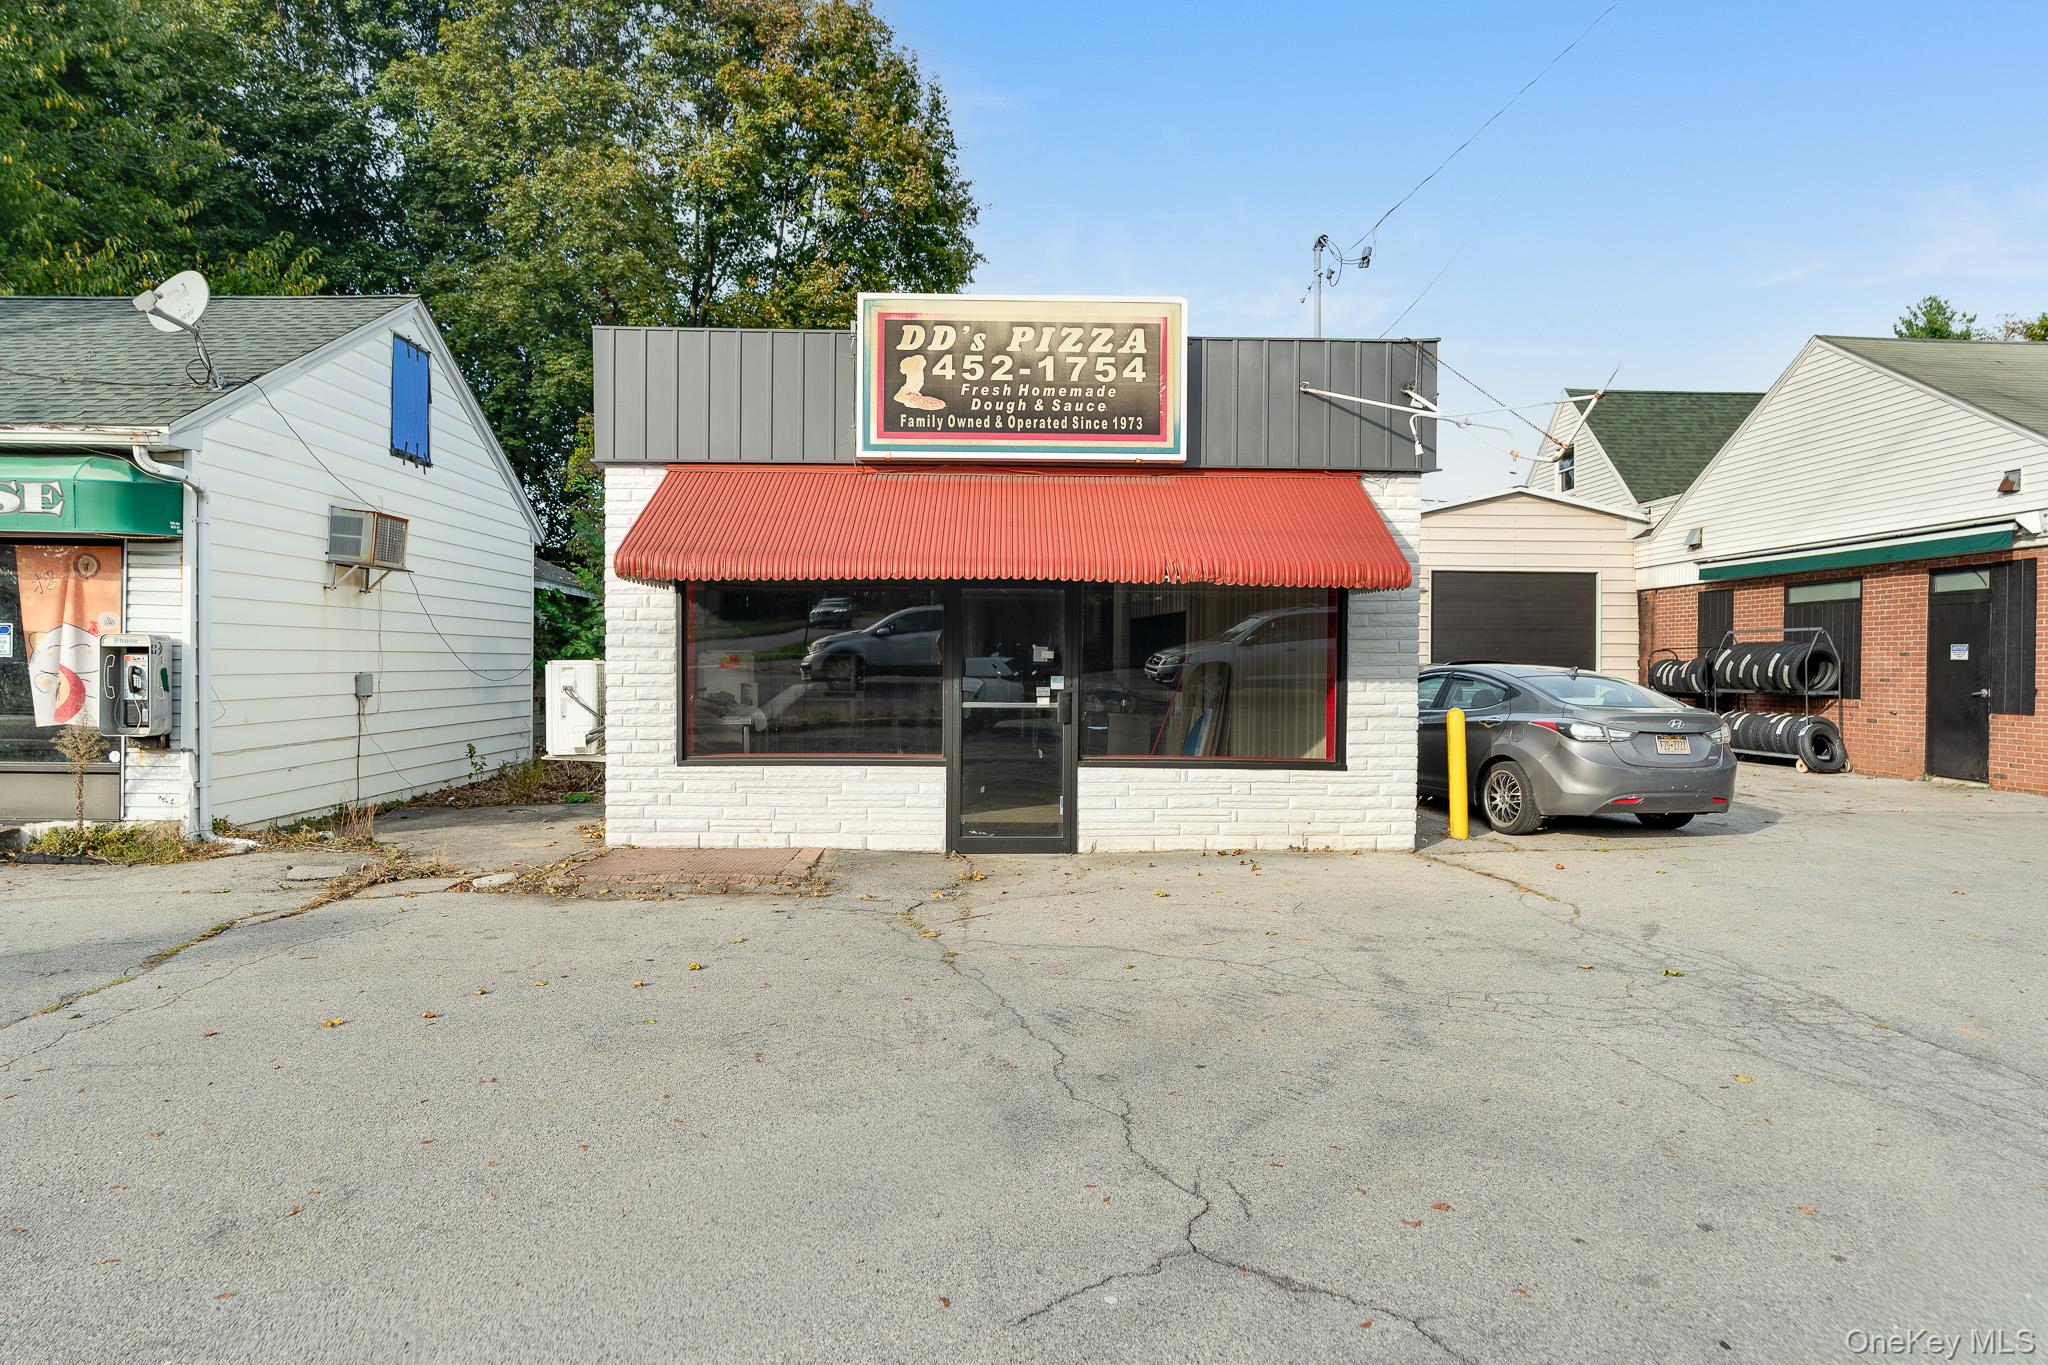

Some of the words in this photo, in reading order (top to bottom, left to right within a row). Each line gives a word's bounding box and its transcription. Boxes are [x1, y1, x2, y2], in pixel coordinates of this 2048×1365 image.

[895, 324, 987, 352] DD's
[1006, 326, 1147, 354] PIZZA
[932, 354, 1147, 383] 452-1754
[961, 383, 1012, 396] Fresh
[1018, 384, 1117, 398] Homemade
[971, 398, 1027, 414] Dough
[1034, 399, 1044, 411] &
[1051, 399, 1107, 412] Sauce
[900, 413, 944, 431] Family
[947, 414, 990, 429] Owned
[994, 415, 1003, 429] &
[1008, 415, 1068, 432] Operated
[1072, 415, 1108, 430] Since
[1112, 416, 1143, 430] 1973
